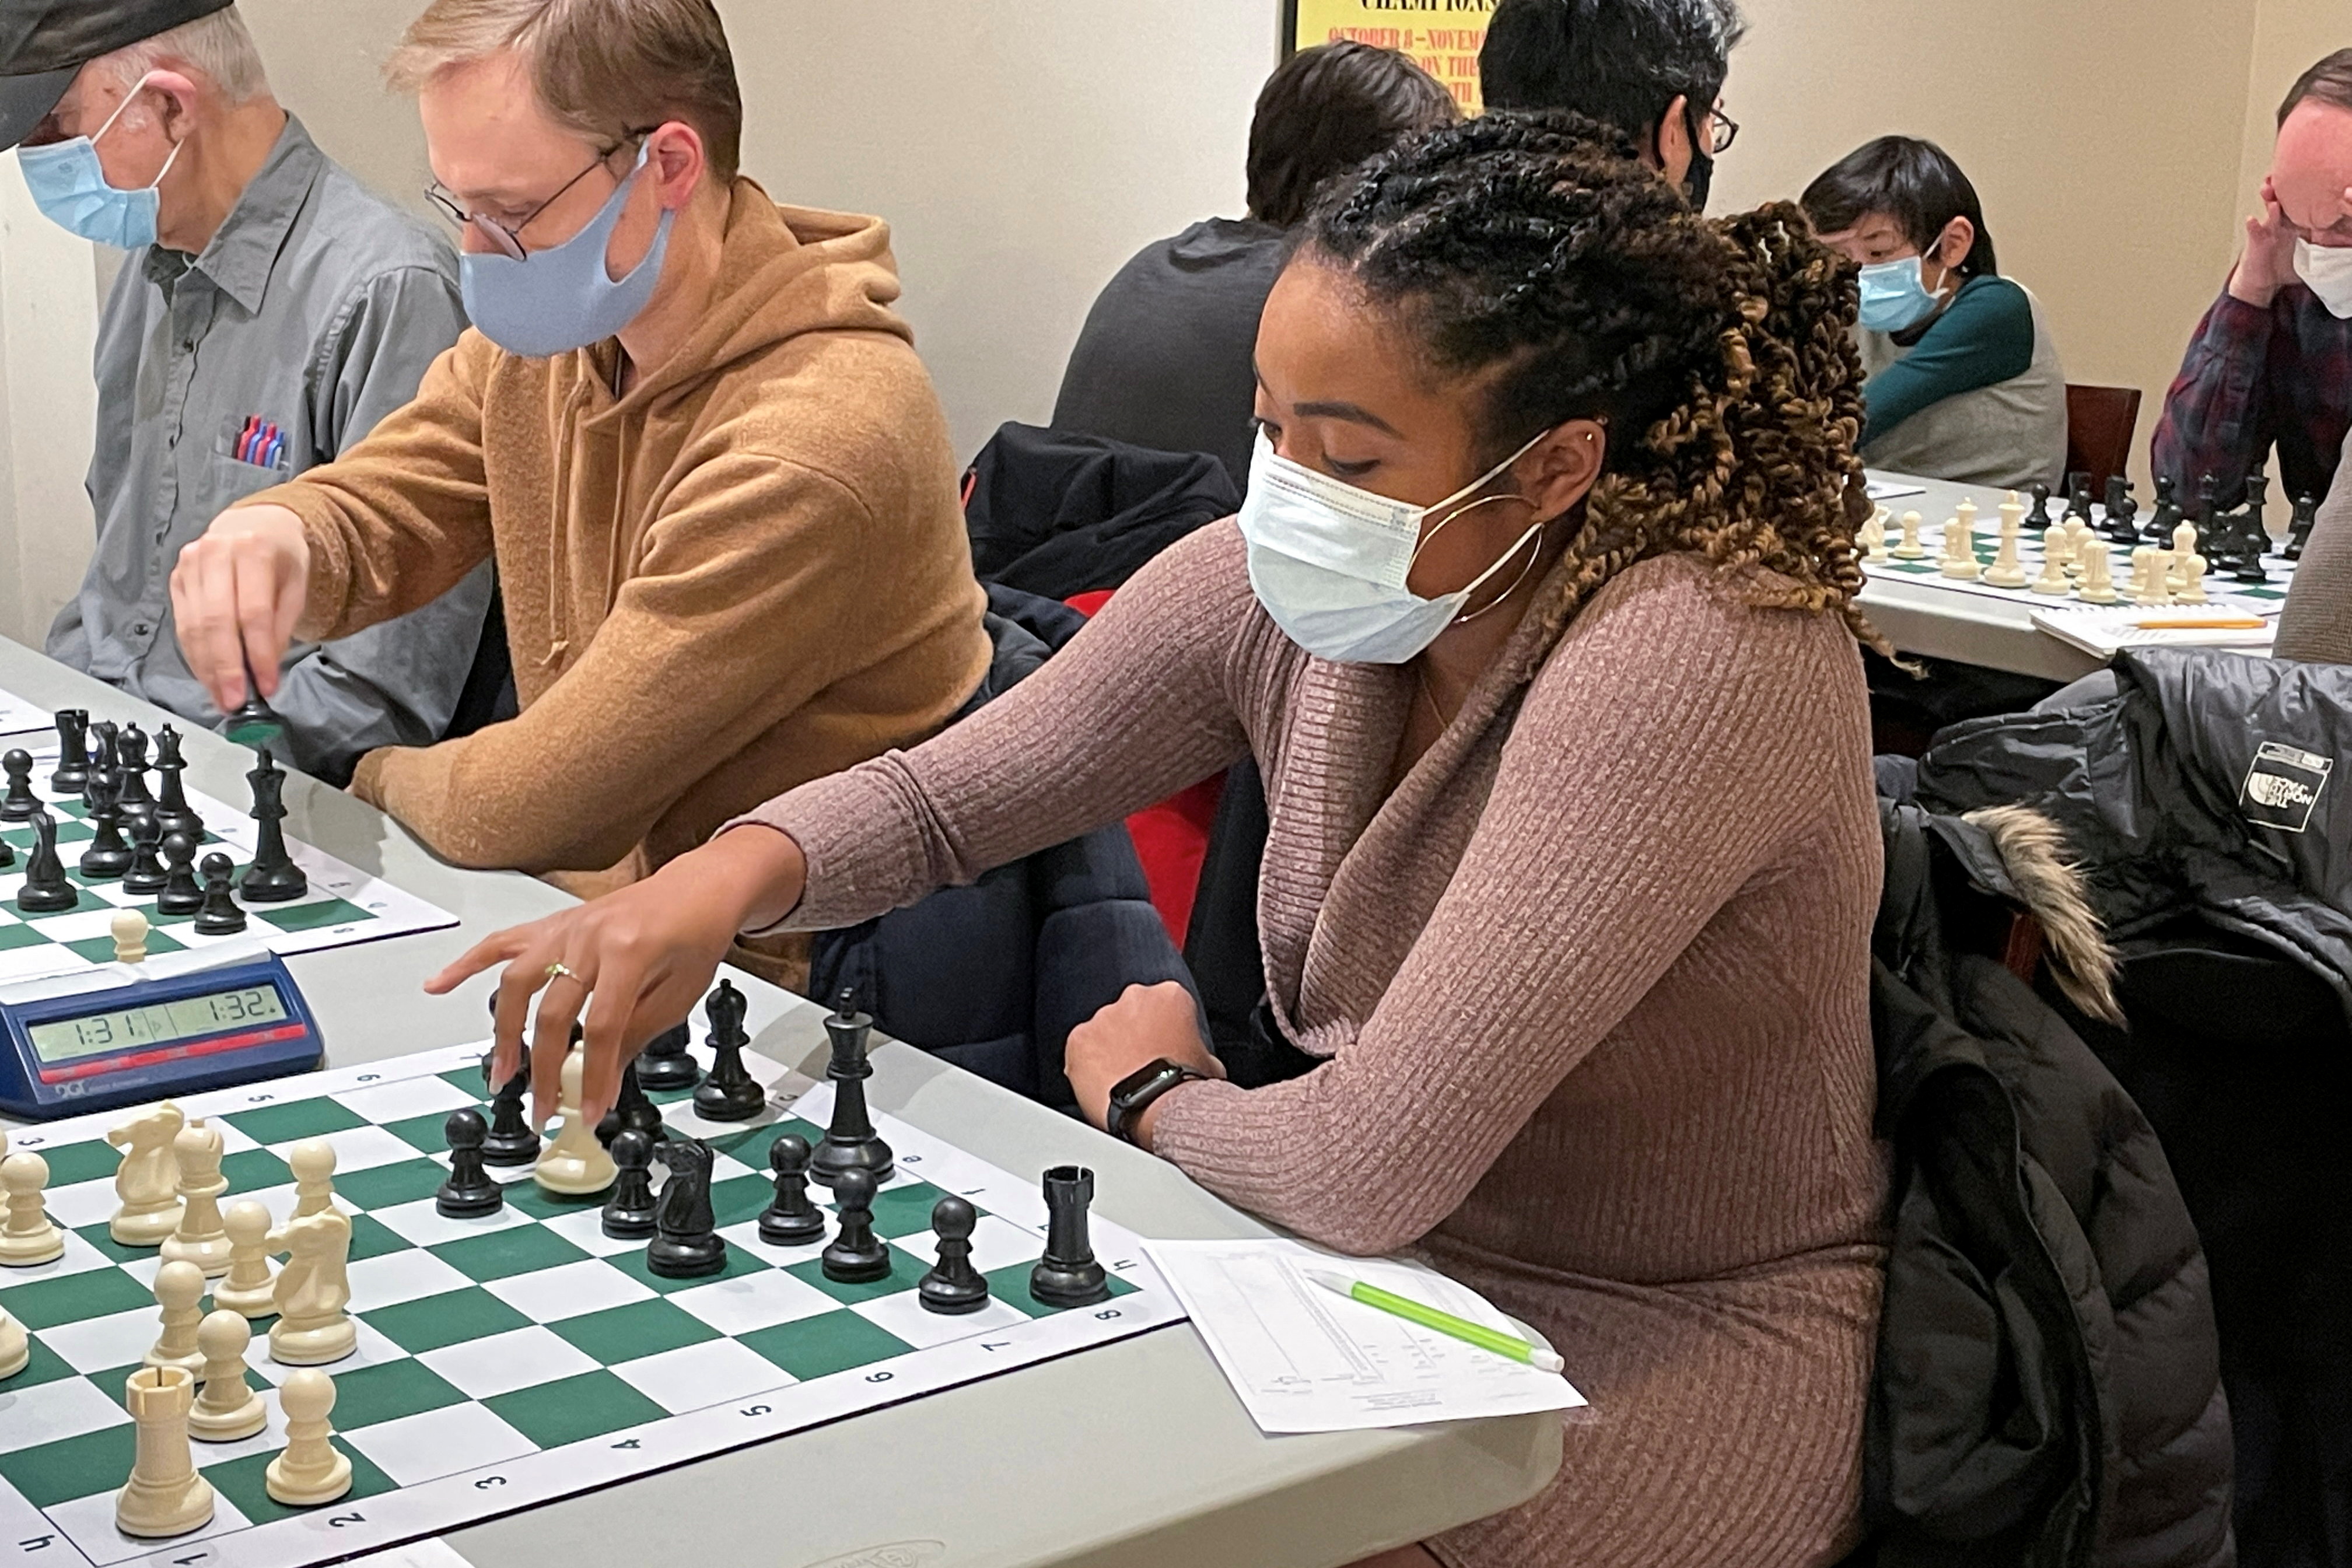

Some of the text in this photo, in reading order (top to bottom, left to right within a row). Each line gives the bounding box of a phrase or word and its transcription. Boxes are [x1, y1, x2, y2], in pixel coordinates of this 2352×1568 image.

[248, 1094, 275, 1102] 5
[1094, 1310, 1122, 1320] 8
[740, 1405, 772, 1416] 5
[610, 1438, 641, 1449] 4
[474, 1476, 507, 1489] 3
[328, 1513, 366, 1528] 2
[173, 1552, 208, 1566] 1
